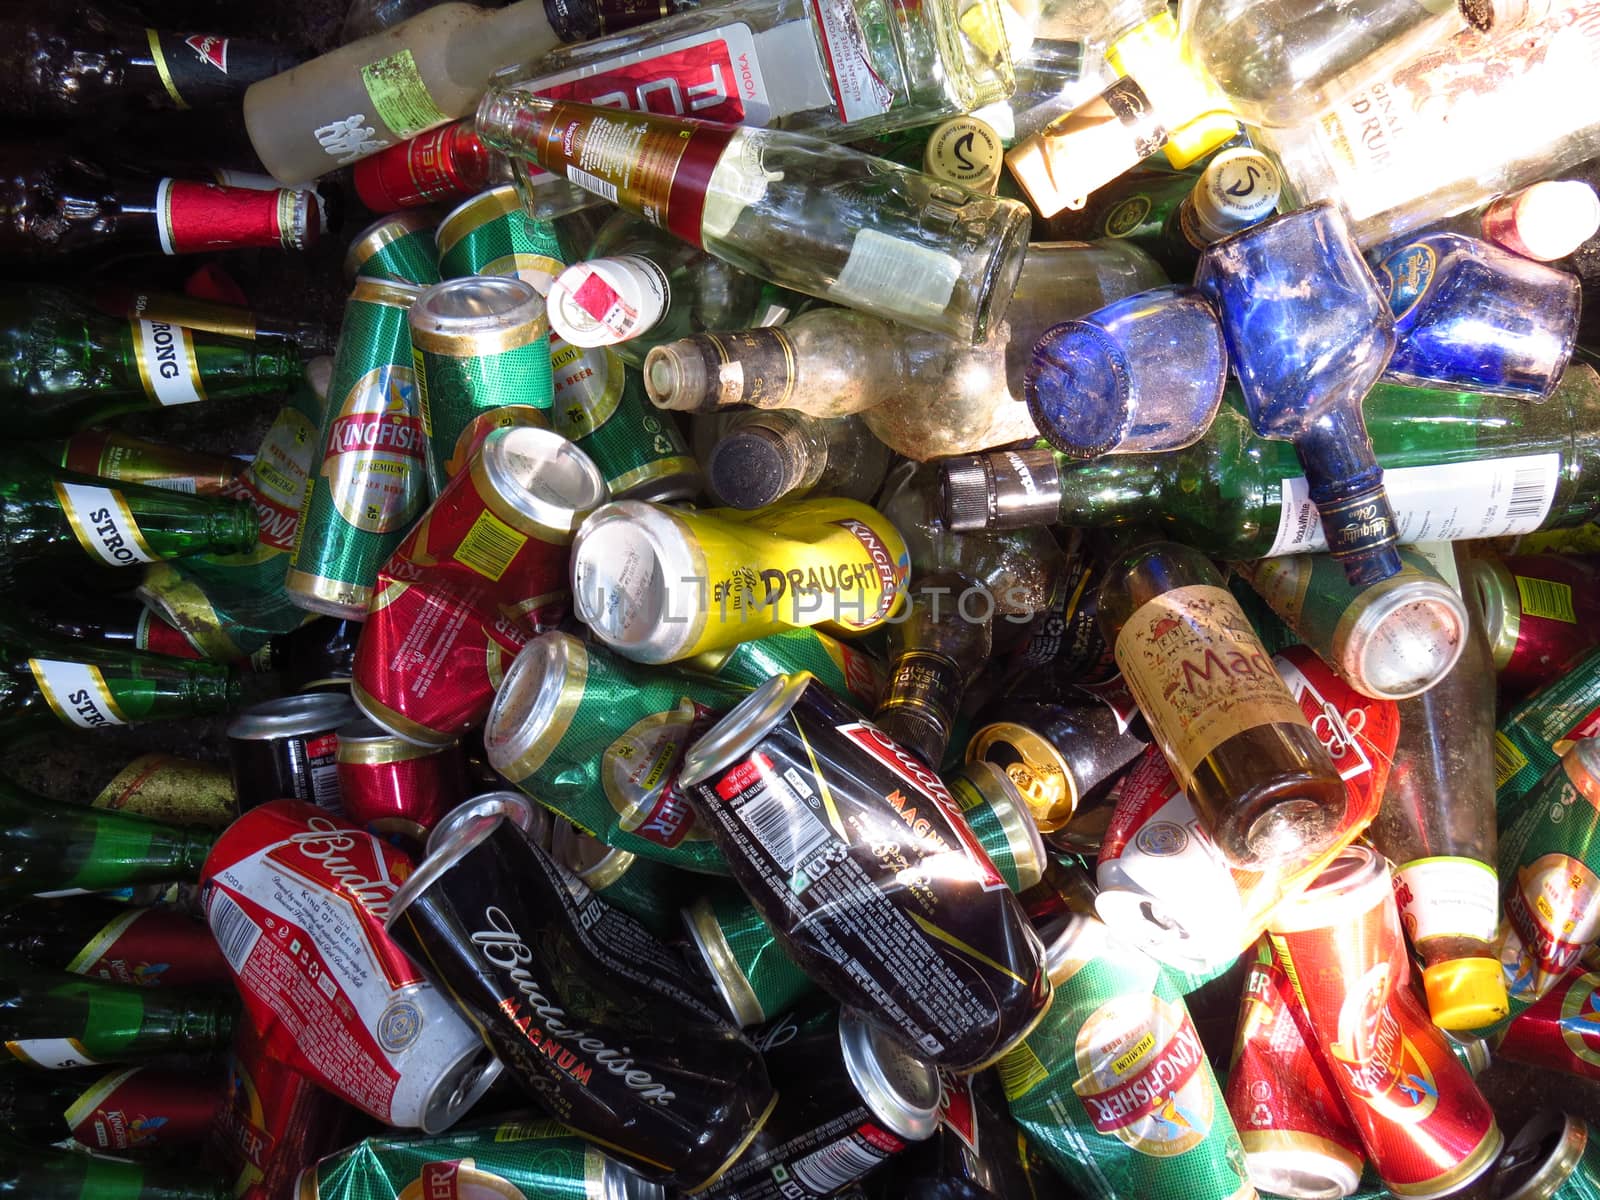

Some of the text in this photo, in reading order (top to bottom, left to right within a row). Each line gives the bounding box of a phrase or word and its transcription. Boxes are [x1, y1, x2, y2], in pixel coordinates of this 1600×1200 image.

[824, 7, 850, 93] PURE GRAIN VODKA
[840, 36, 861, 101] RUSSIAN TRIPLE
[736, 52, 756, 98] VODKA
[563, 119, 580, 156] KINGFISHER
[150, 319, 181, 381] RONG
[566, 367, 594, 388] BEER
[759, 561, 877, 606] DRAUGHT
[222, 870, 240, 889] 500
[299, 888, 362, 957] KING OF BEERS
[320, 898, 350, 933] PREMIUM
[861, 911, 891, 942] TRADEMARK
[864, 928, 892, 956] CUSTOMER
[887, 952, 902, 967] CARE
[889, 906, 914, 931] PRIVILEGE
[908, 928, 937, 957] INDUSTRIES
[943, 966, 958, 980] PLOT
[890, 921, 911, 942] SATARA
[927, 962, 964, 999] MAHARASHTRA
[904, 947, 918, 961] PLOT
[881, 960, 909, 988] CUSTOMER
[471, 905, 677, 1107] Budweiser
[499, 996, 595, 1087] MAGNUM
[1111, 1037, 1156, 1071] PREMIUM
[1097, 1023, 1200, 1125] KINGFISHER
